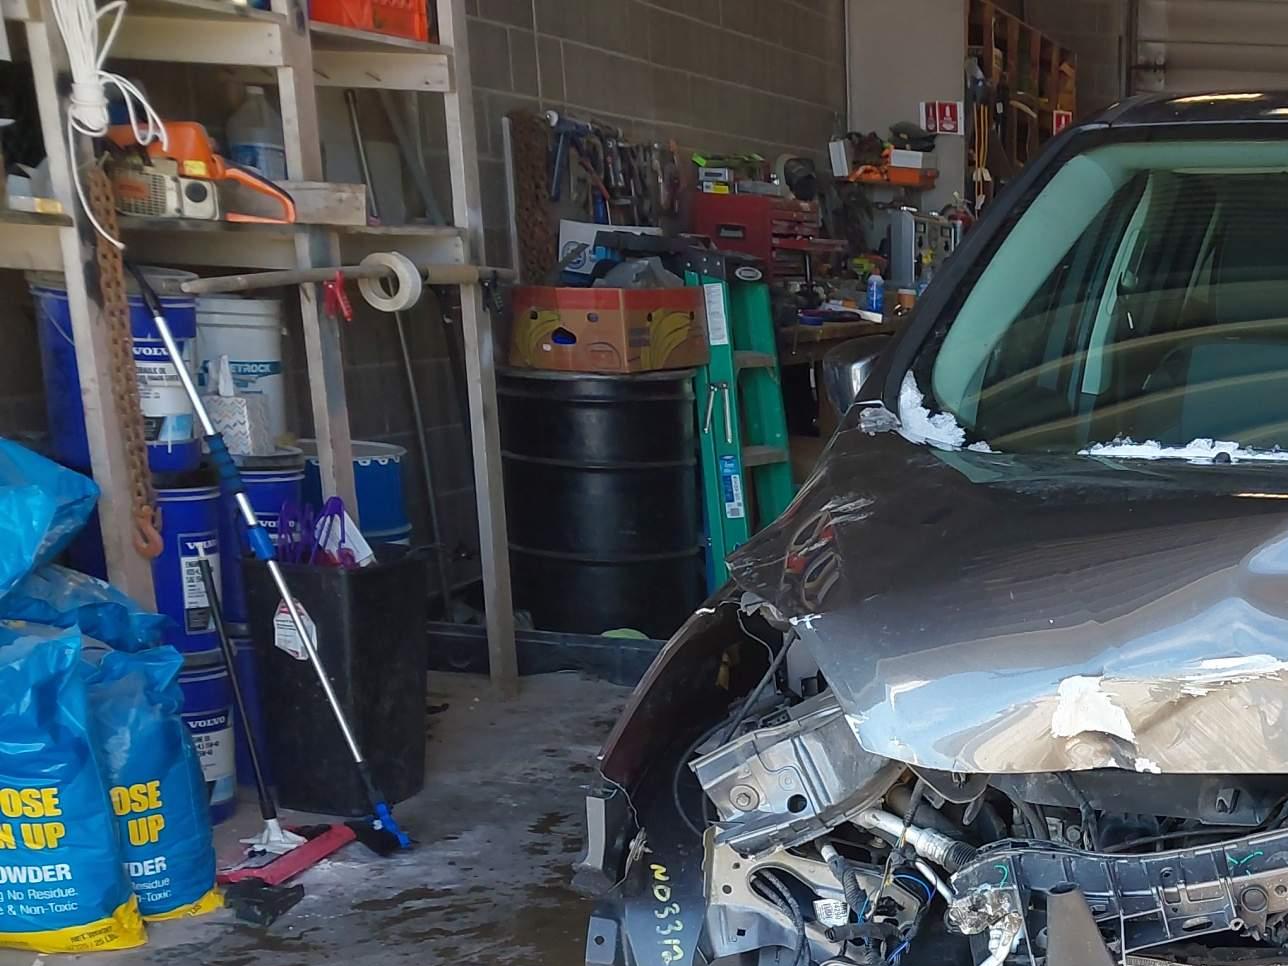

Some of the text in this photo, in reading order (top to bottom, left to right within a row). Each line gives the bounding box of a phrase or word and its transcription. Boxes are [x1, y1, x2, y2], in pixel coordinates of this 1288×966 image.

[132, 347, 169, 356] VOLV
[188, 716, 226, 728] VOLVO
[0, 787, 62, 817] OSE
[20, 822, 65, 849] UP
[128, 814, 165, 846] UP
[7, 889, 24, 900] No
[20, 902, 78, 915] Non-Toxic
